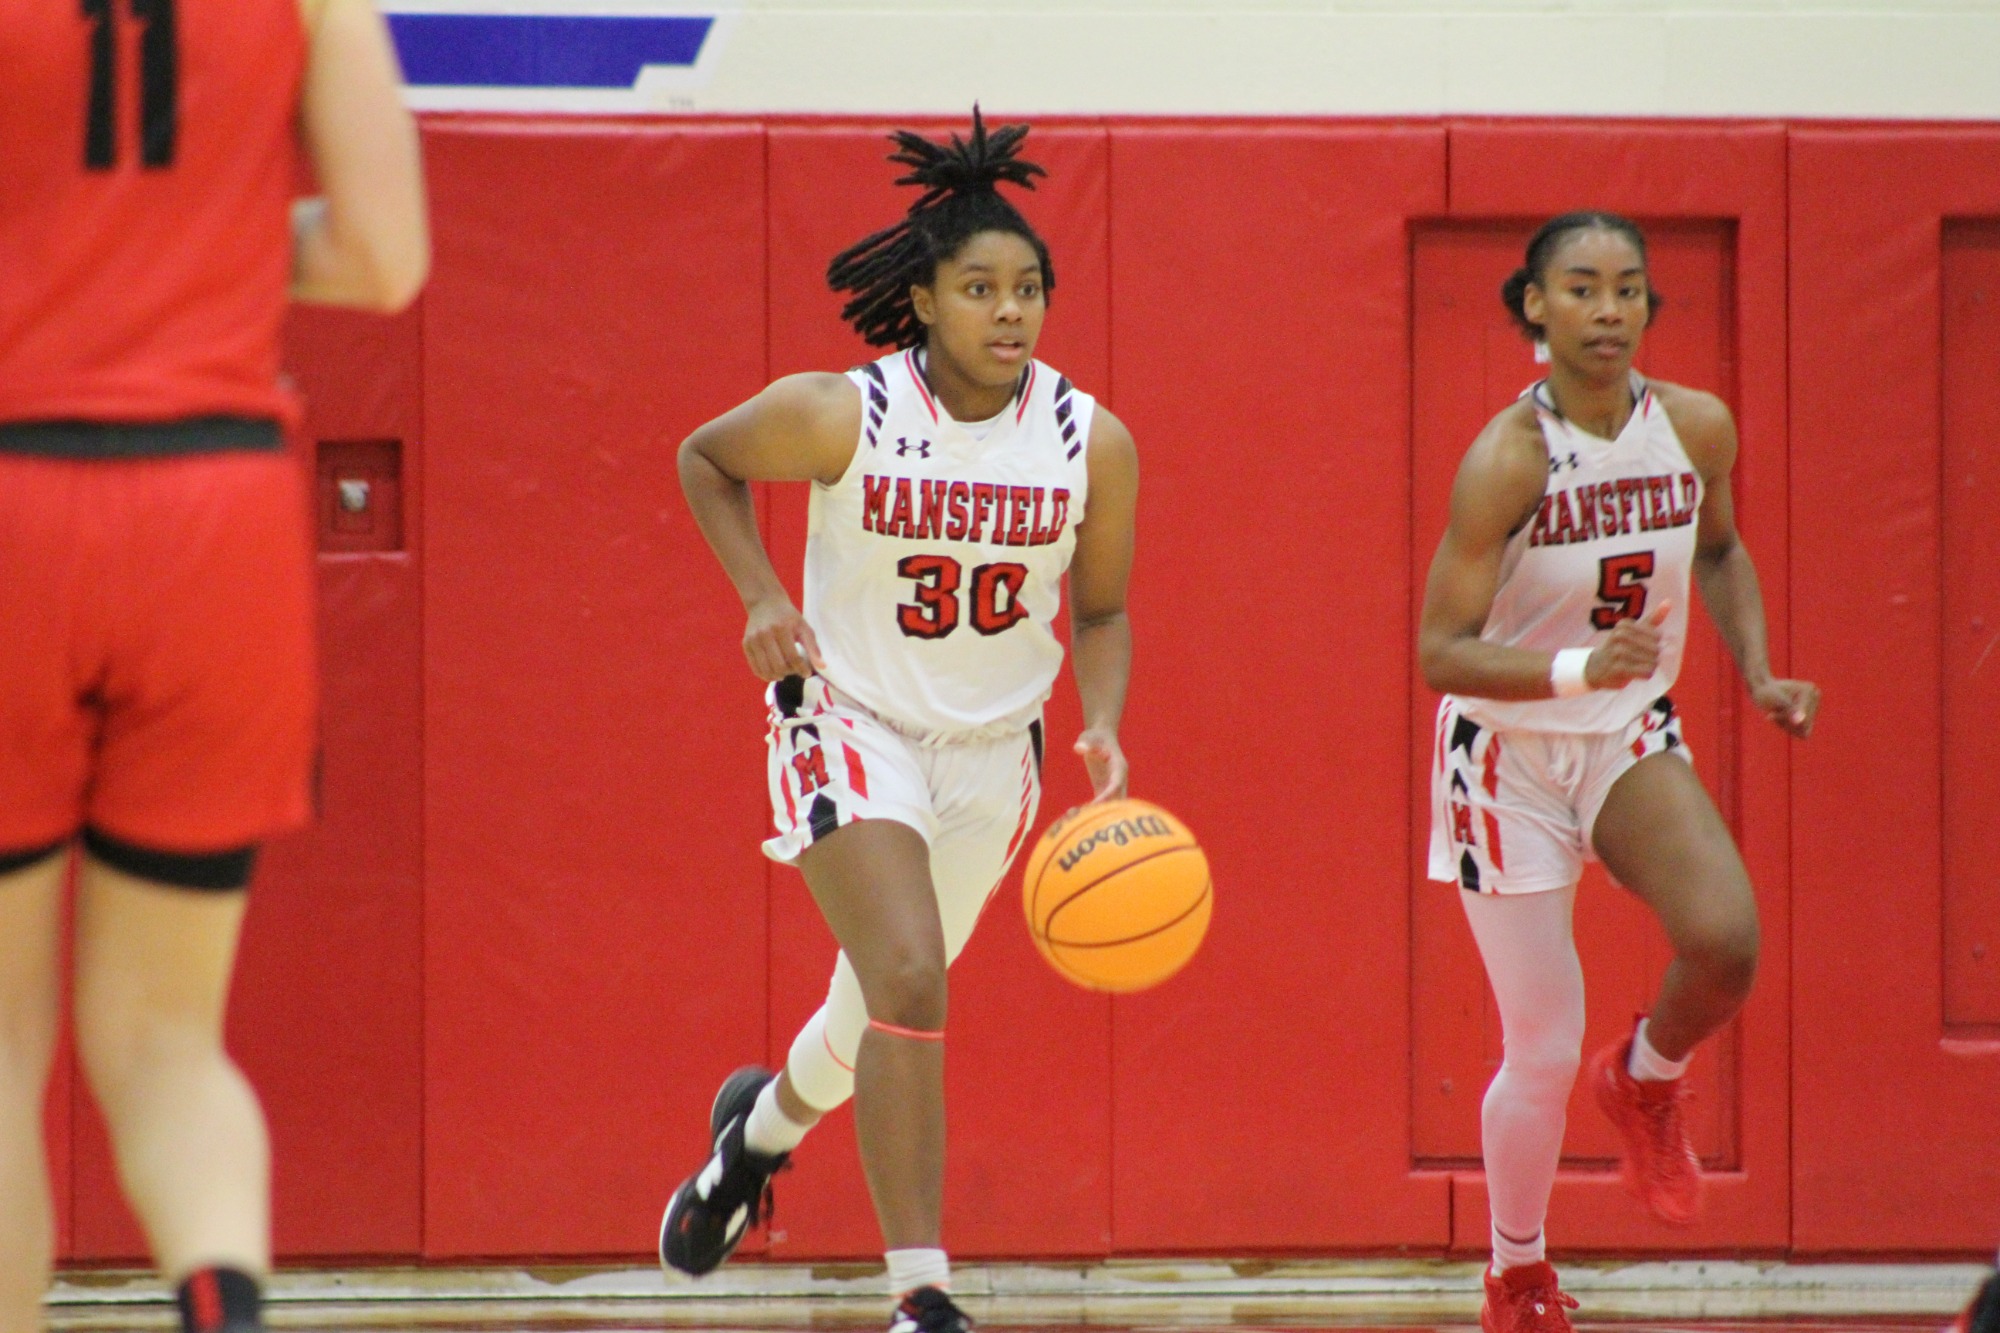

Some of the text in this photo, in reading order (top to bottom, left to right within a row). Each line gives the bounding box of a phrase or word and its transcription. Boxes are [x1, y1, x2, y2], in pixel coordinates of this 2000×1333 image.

[80, 0, 177, 170] 11
[863, 474, 1070, 547] MANSFIELD
[897, 554, 1029, 640] 30
[1590, 550, 1656, 631] 5
[792, 743, 830, 798] M
[1452, 800, 1477, 846] M
